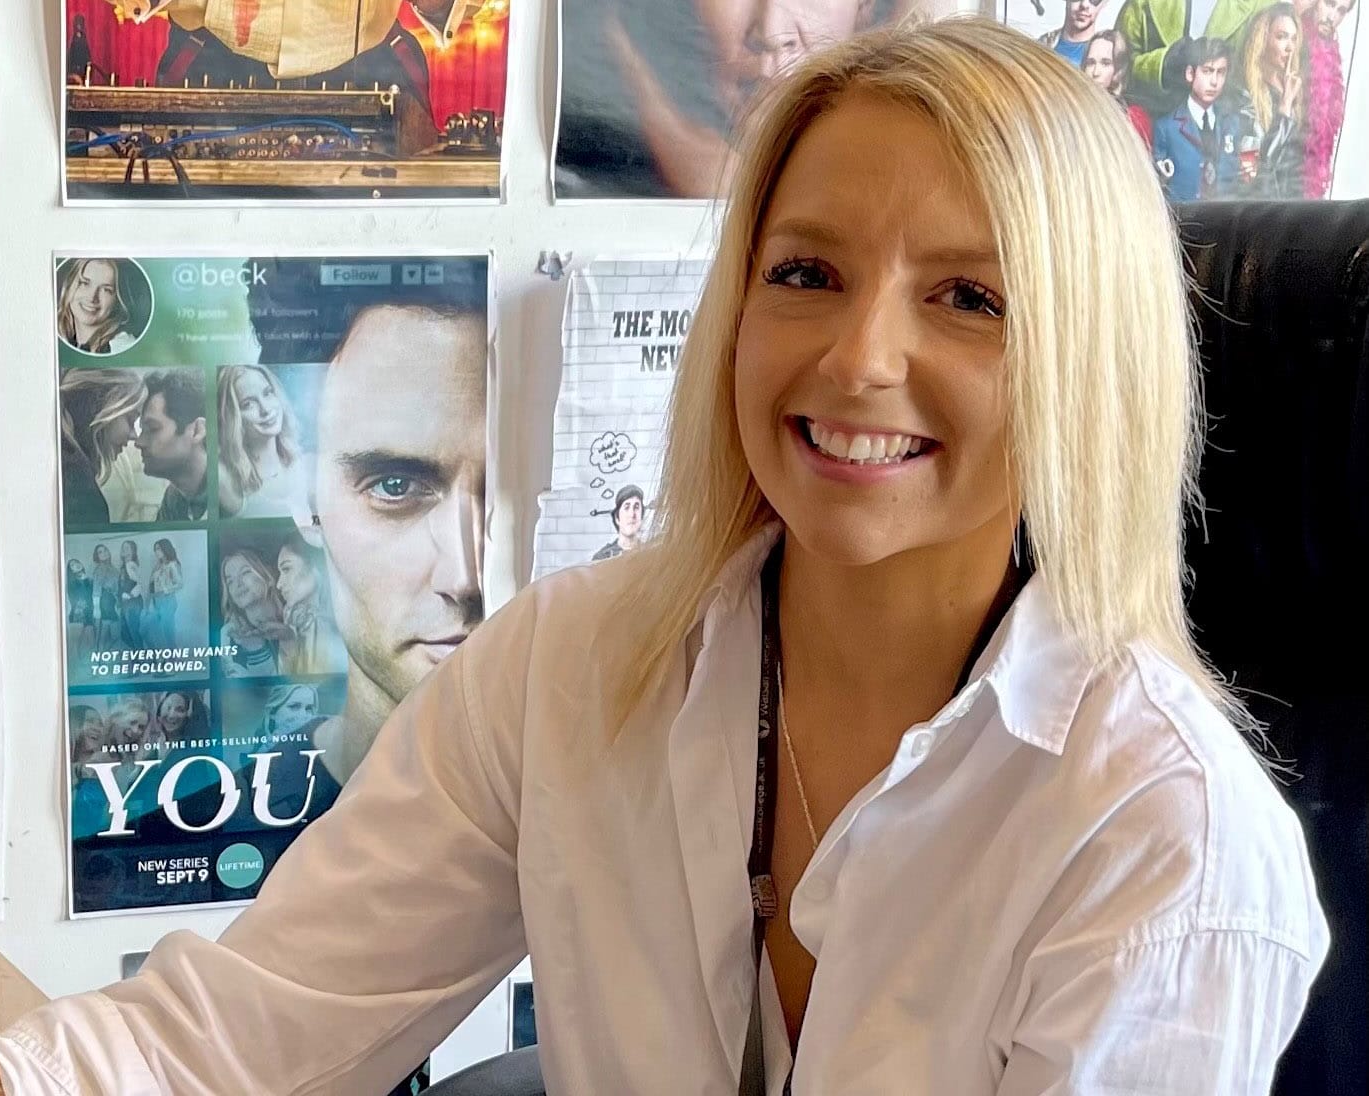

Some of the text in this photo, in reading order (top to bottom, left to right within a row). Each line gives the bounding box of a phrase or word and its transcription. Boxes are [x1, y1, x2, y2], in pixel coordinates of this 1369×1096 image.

[172, 263, 379, 290] @beck Follow
[613, 311, 653, 337] THE
[91, 645, 238, 663] NOT EVERYONE WANTS
[91, 660, 207, 676] TO BE FOLLOWED.
[101, 743, 139, 753] BASED
[143, 742, 161, 751] ON
[164, 740, 186, 750] THE
[272, 733, 309, 744] NOVEL
[85, 750, 327, 837] YOU
[138, 857, 209, 872] NEW SERIES
[219, 862, 262, 871] LIFETIME
[156, 870, 209, 885] SEPT 9
